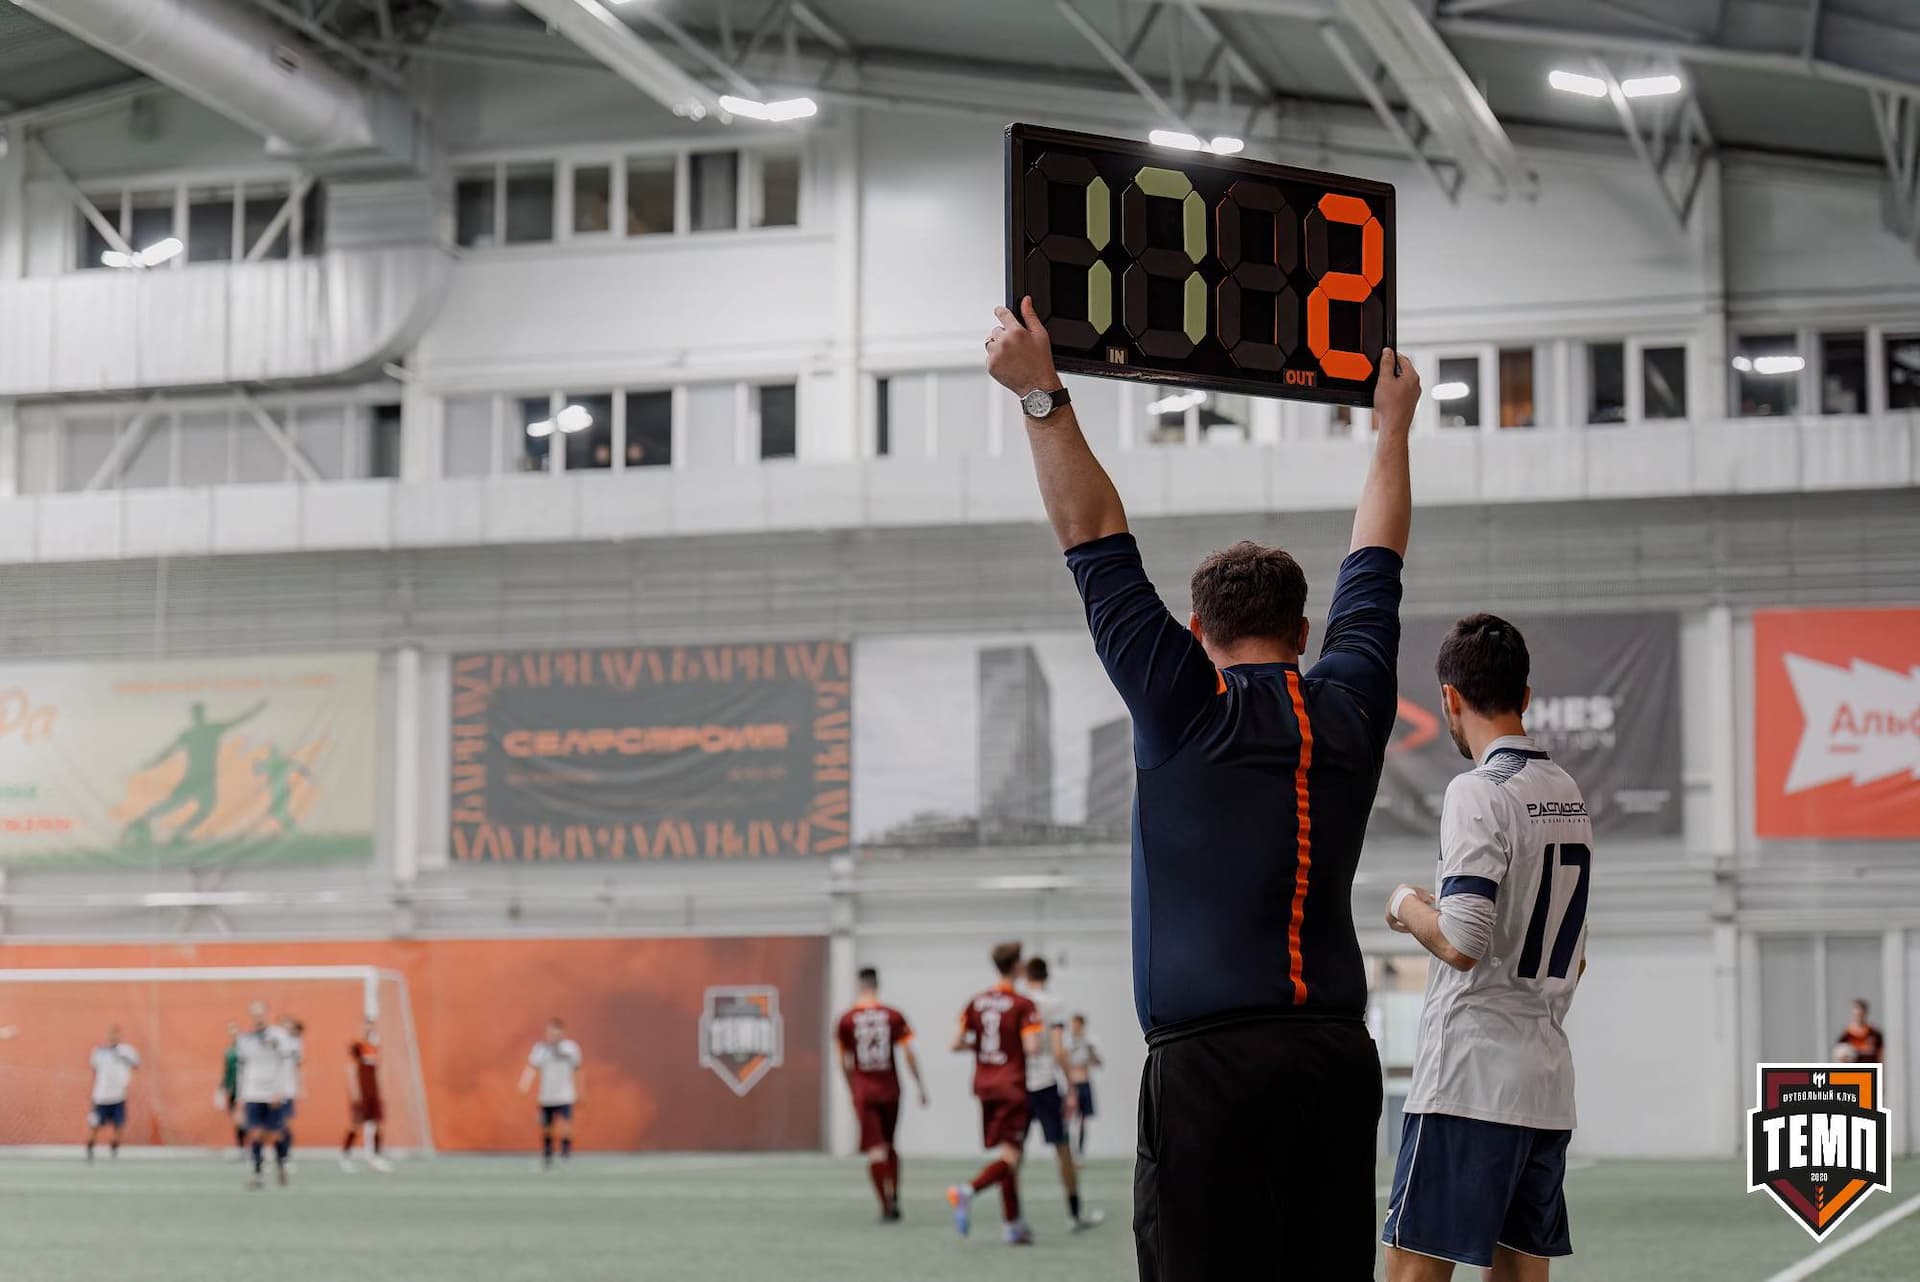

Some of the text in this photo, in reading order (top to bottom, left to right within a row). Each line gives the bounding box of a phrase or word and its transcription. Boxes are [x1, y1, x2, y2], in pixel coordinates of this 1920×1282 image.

[1086, 166, 1207, 345] 17
[1307, 193, 1384, 381] 2
[1109, 348, 1126, 365] IN
[1285, 368, 1316, 386] OUT
[1517, 843, 1591, 979] 17
